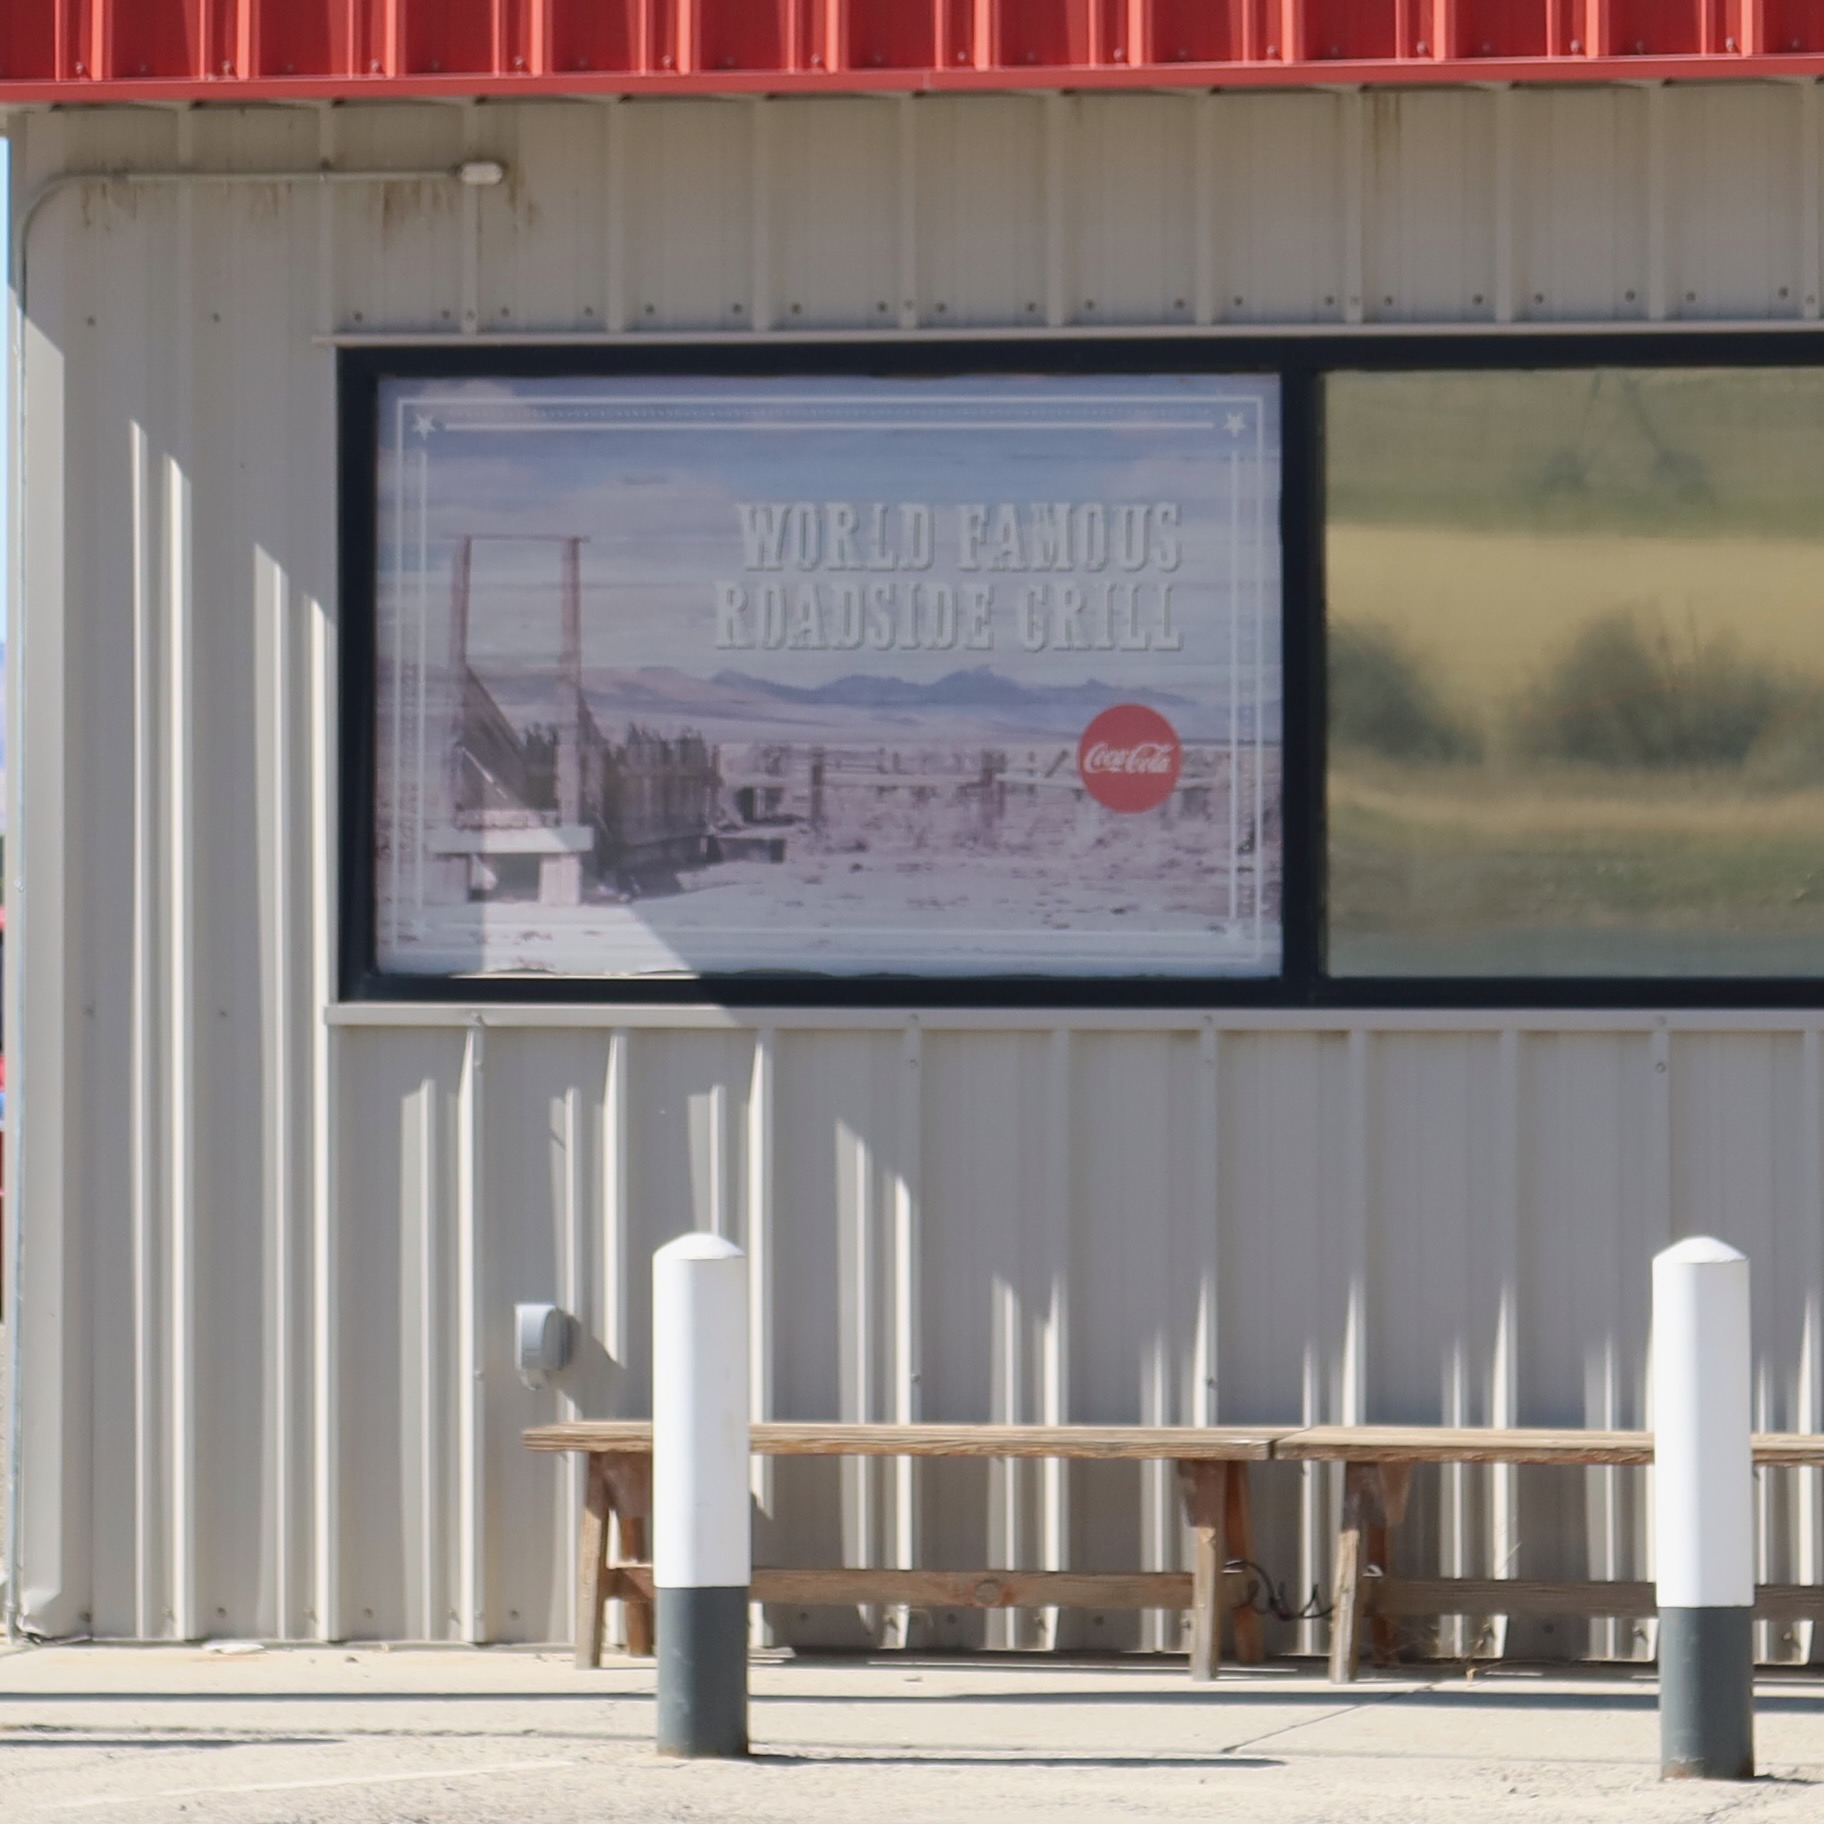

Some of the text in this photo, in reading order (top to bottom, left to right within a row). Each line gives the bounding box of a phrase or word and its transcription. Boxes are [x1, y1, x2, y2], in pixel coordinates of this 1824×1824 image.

[736, 501, 1183, 573] WORLD FAMOUS
[714, 580, 1185, 653] ROADSIDE GRILL
